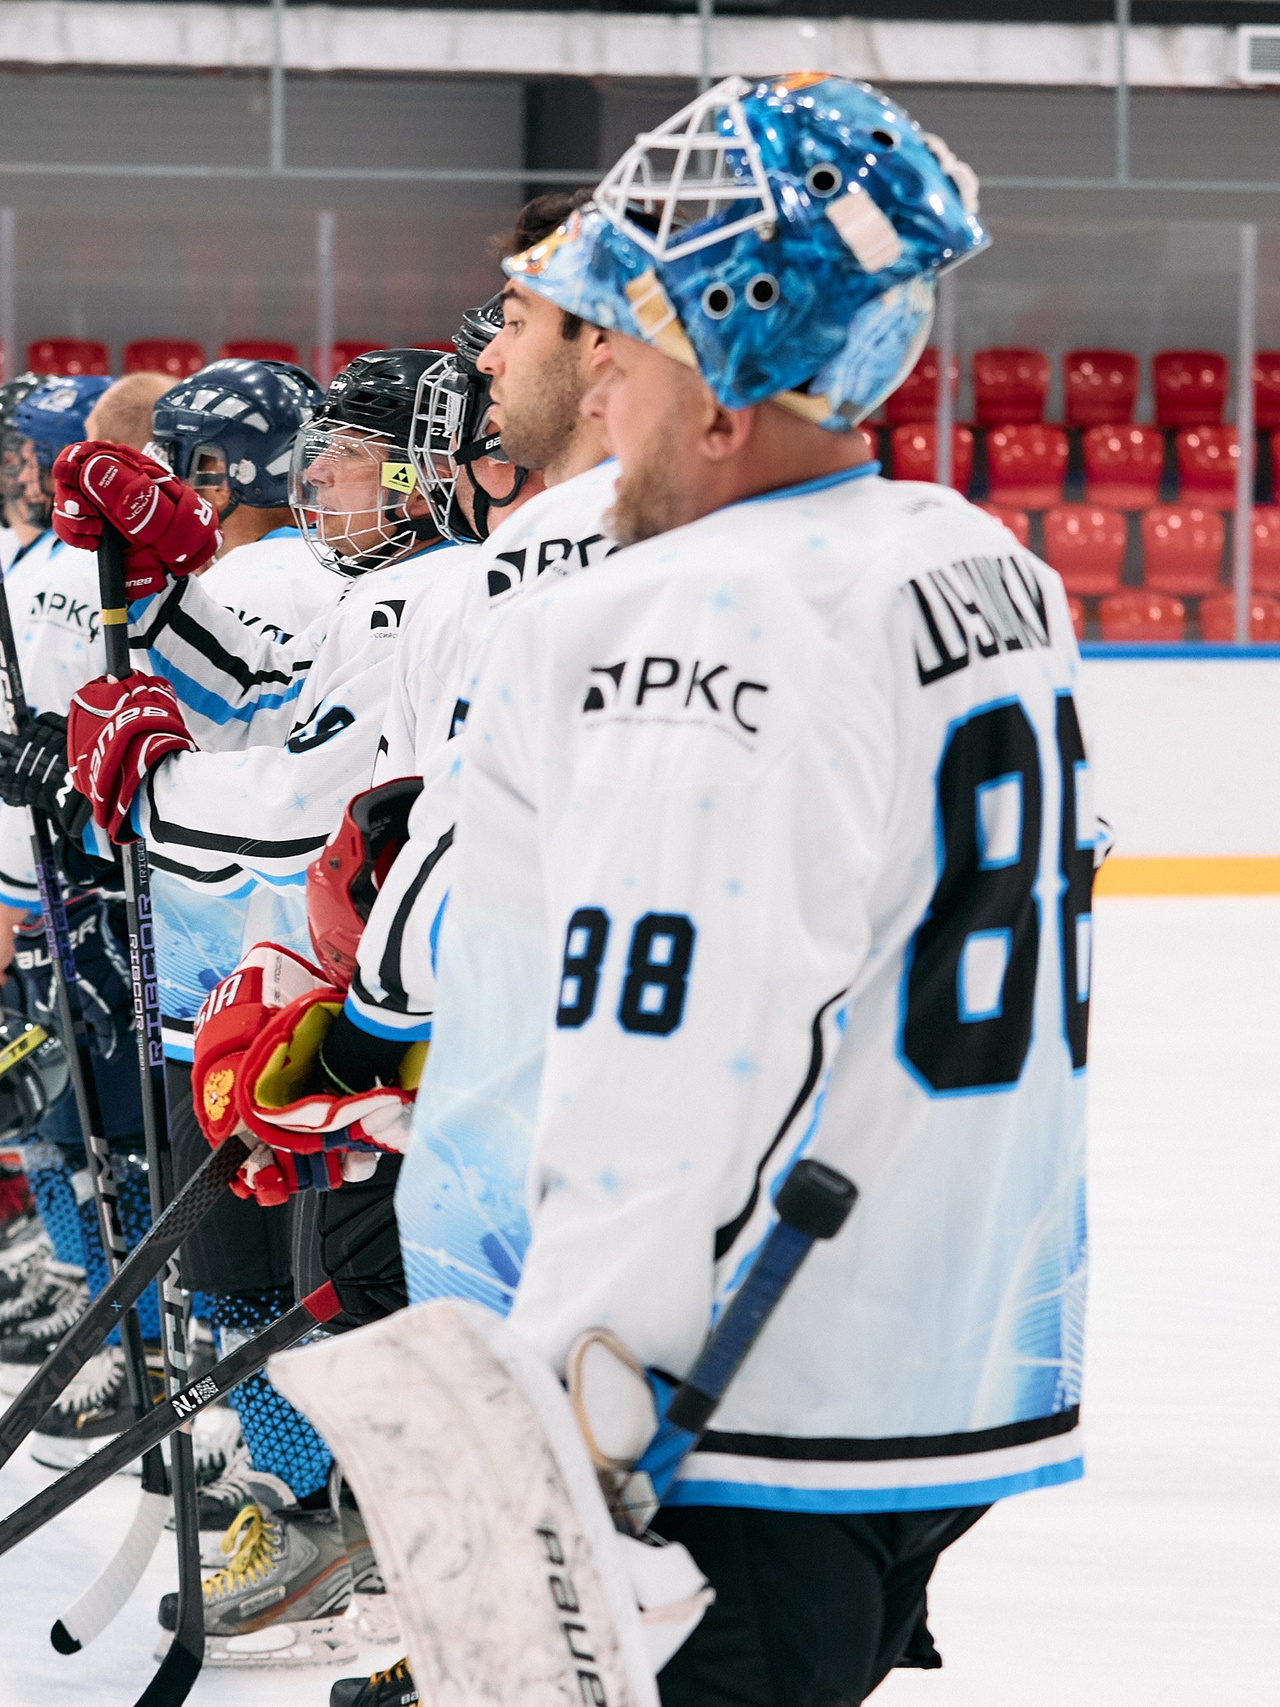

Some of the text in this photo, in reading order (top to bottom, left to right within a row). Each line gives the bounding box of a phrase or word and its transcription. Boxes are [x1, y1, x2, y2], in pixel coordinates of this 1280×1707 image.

[636, 656, 769, 733] РКС
[13, 914, 97, 971] AUER
[128, 932, 144, 1030] RIBCOR
[135, 892, 165, 1066] RIBCOR
[556, 907, 697, 1037] 88
